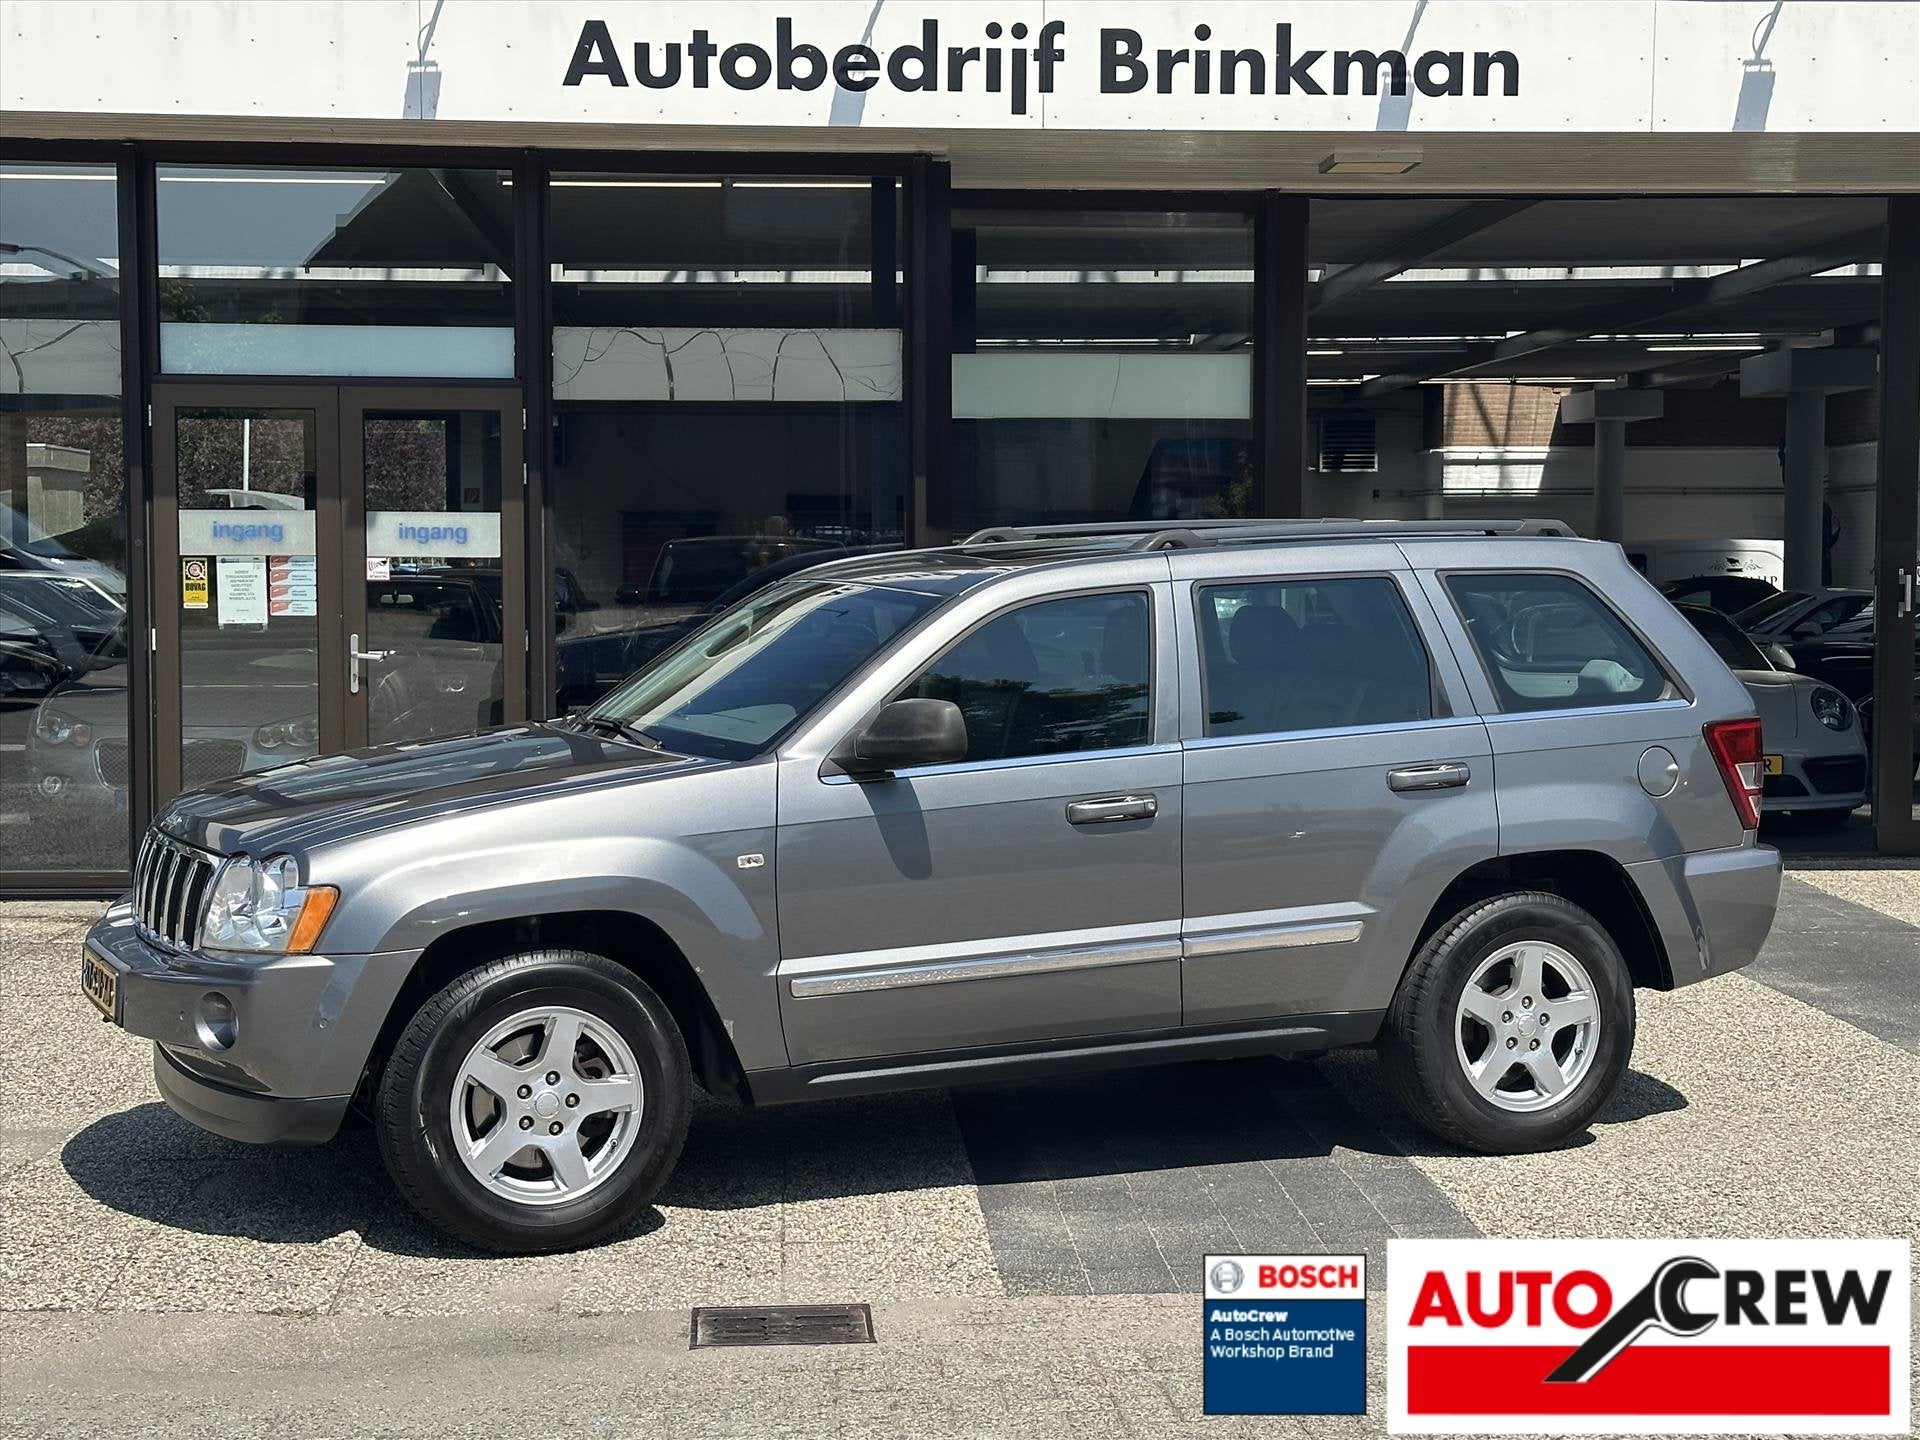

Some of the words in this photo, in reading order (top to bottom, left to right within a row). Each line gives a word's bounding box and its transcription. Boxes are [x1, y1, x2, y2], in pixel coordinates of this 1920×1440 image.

[562, 17, 1065, 115] Autobedrijf
[1099, 23, 1519, 97] Brinkman
[212, 521, 284, 542] ingang
[398, 523, 468, 544] ingang
